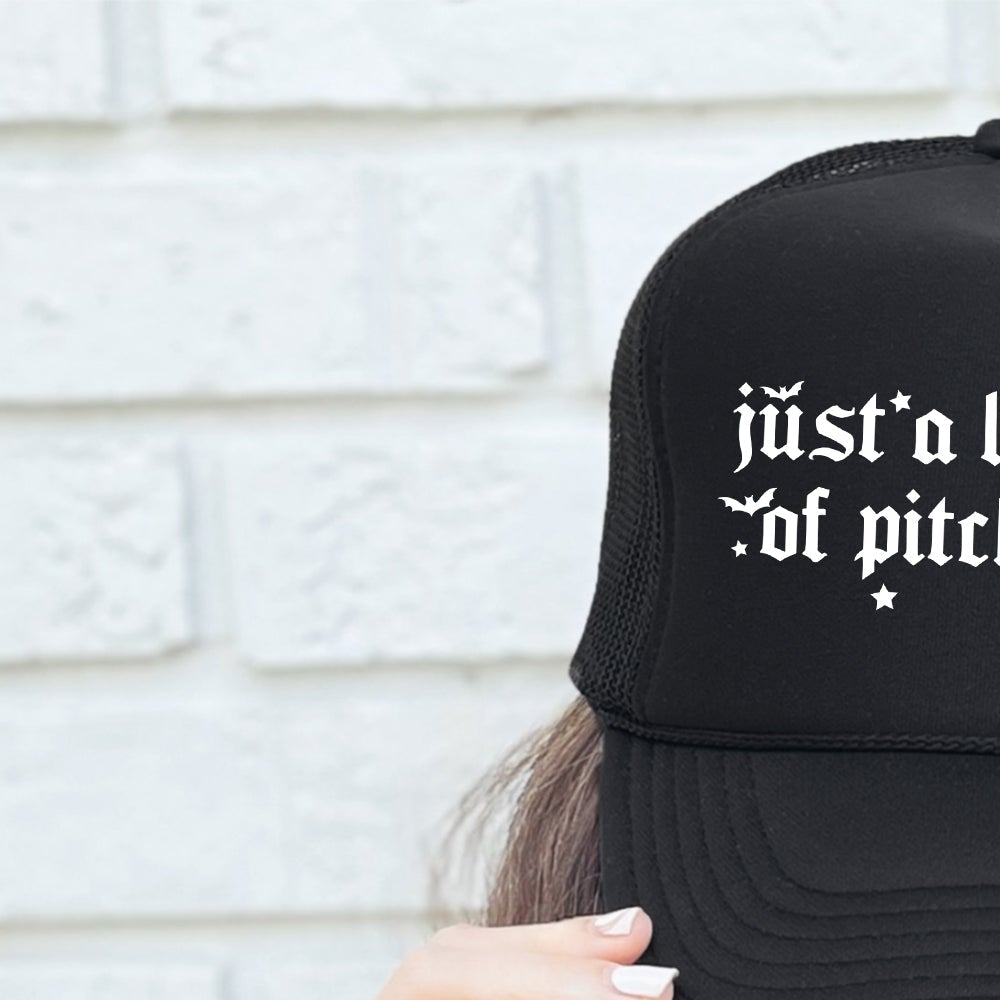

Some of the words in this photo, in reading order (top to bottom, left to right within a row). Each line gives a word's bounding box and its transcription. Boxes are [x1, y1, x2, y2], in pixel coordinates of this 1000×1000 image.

[733, 382, 886, 474] just
[912, 408, 958, 465] a
[759, 486, 831, 563] of
